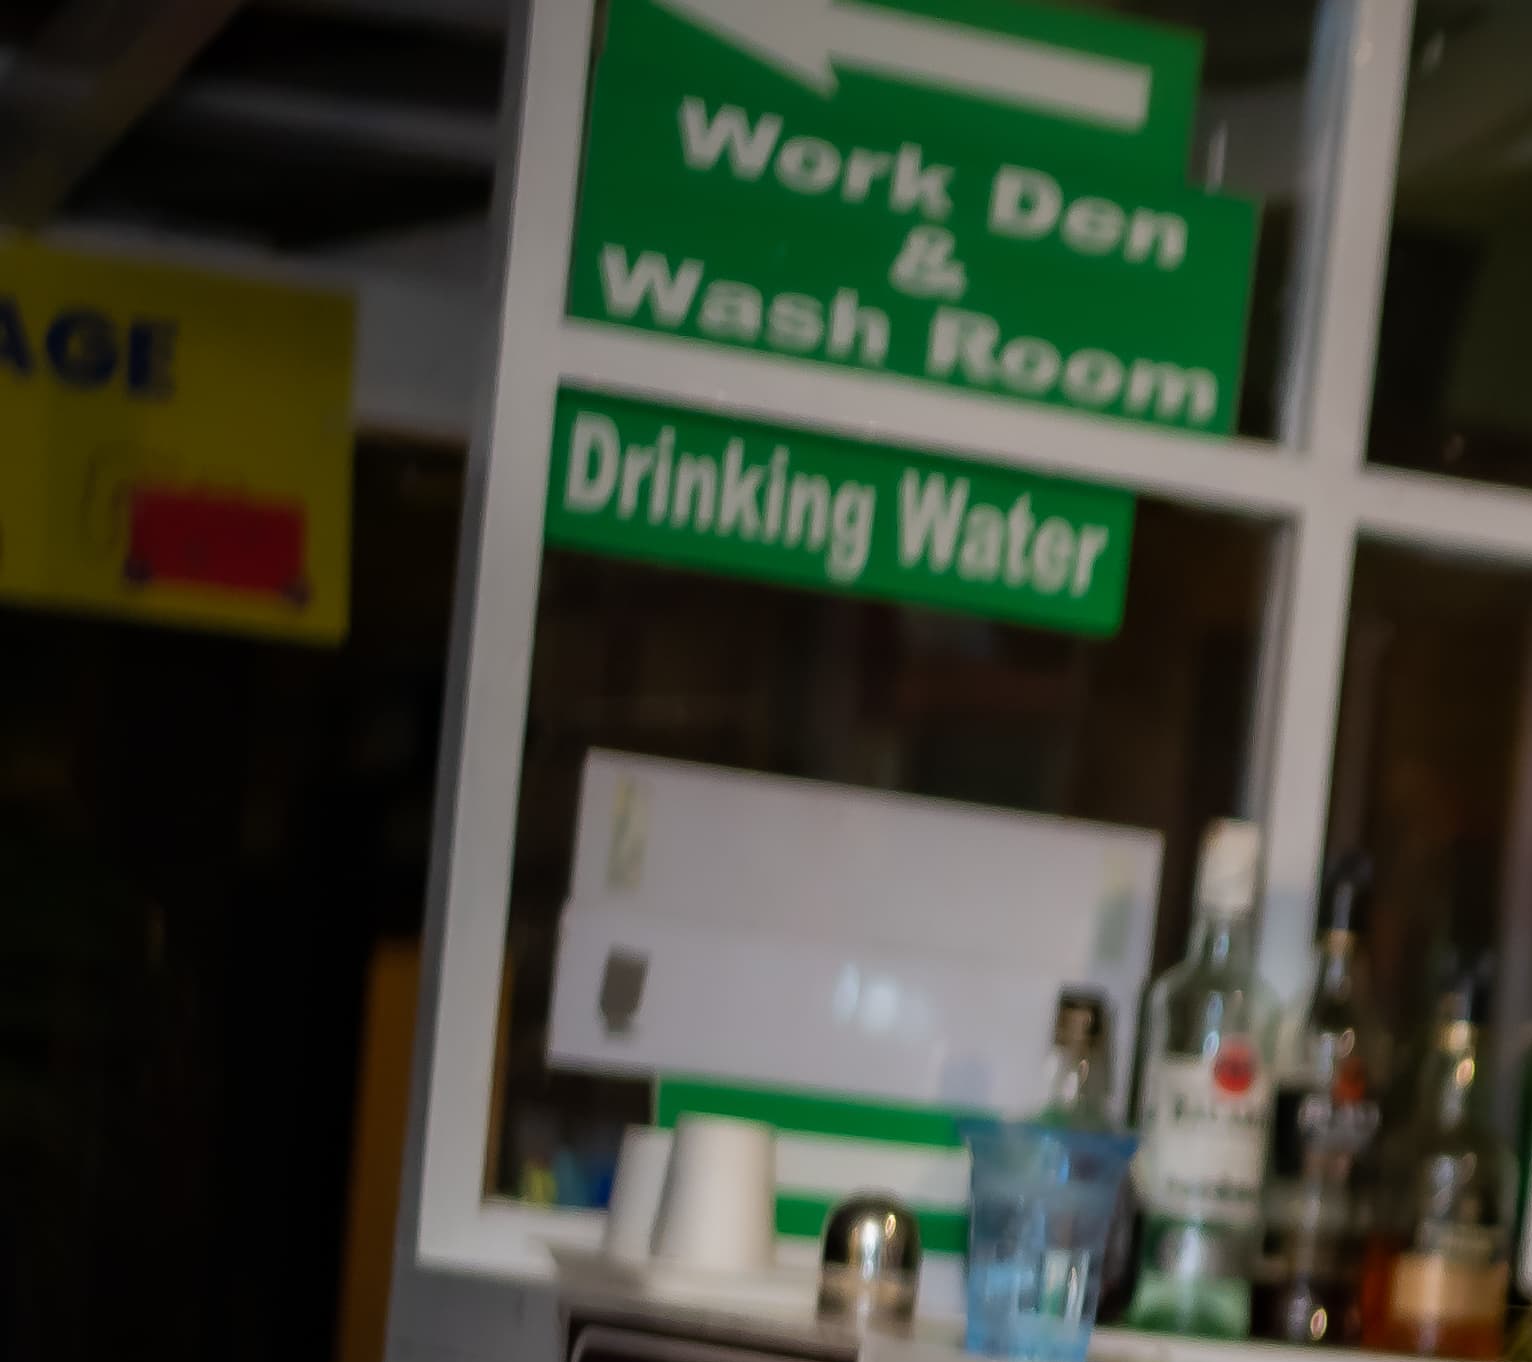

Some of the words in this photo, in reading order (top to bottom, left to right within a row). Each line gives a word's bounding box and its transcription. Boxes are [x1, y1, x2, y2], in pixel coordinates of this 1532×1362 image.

[678, 95, 955, 219] Work
[988, 163, 1189, 269] Den
[889, 224, 967, 299] &
[601, 243, 890, 366] Wash
[926, 305, 1218, 425] Room
[565, 410, 876, 582] Drinking
[900, 467, 1108, 597] Water
